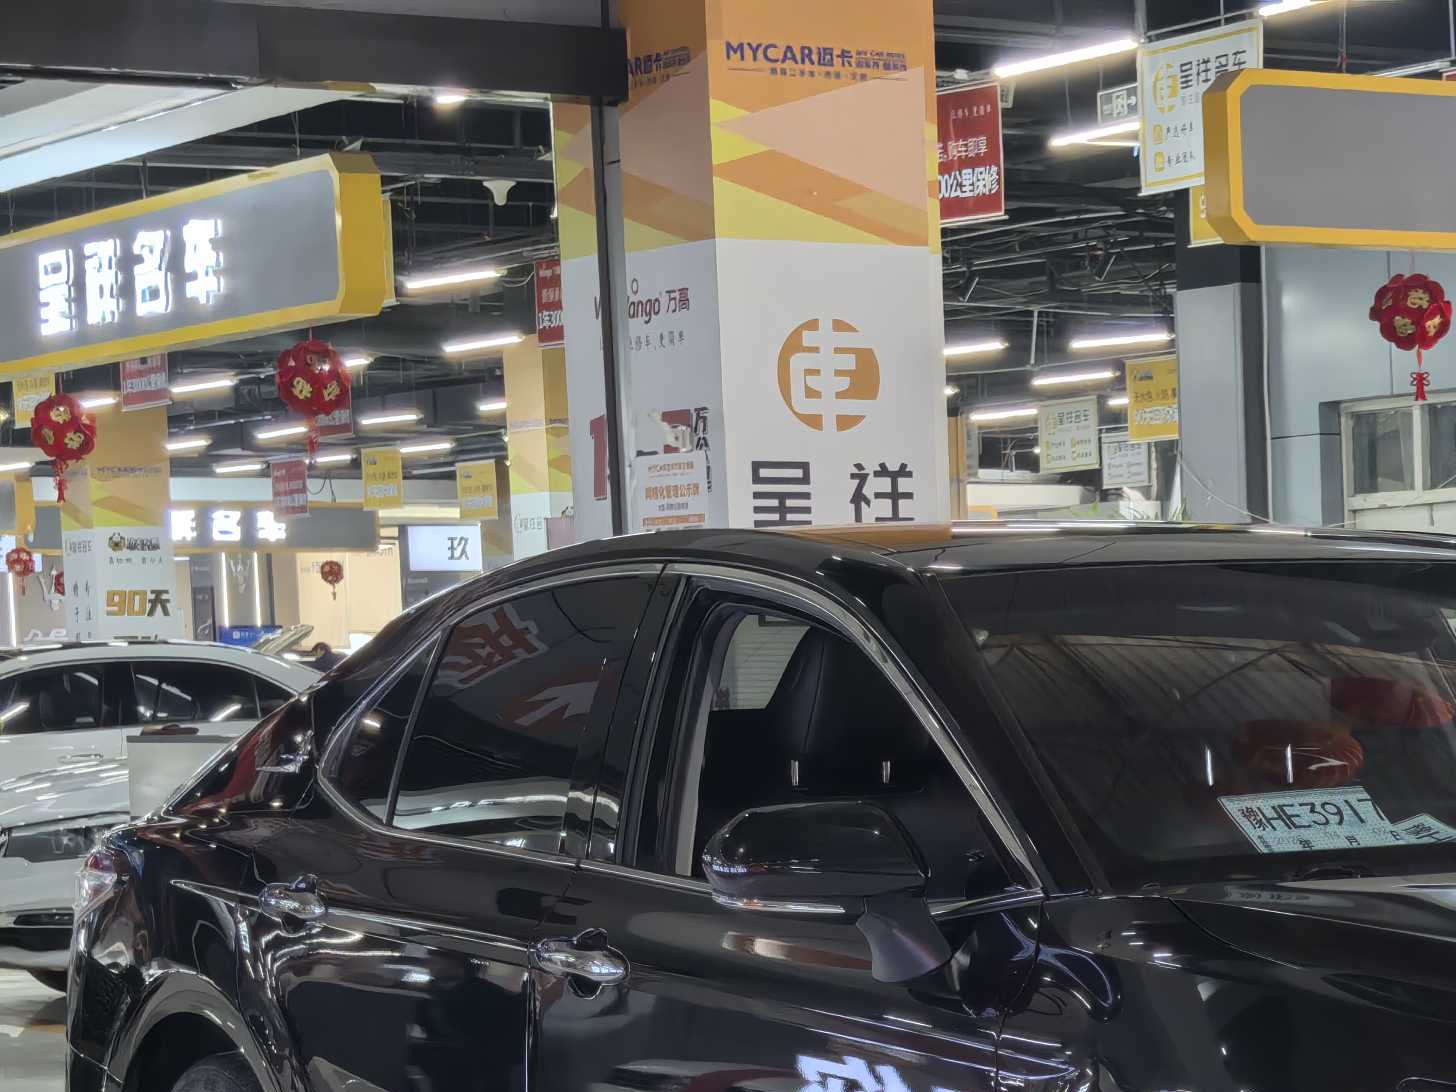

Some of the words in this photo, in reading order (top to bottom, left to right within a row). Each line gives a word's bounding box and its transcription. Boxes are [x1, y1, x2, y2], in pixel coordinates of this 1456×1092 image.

[37, 217, 225, 337] 呈祥名车
[751, 460, 915, 528] 呈祥
[447, 536, 470, 561] 玖
[106, 589, 171, 617] 90天
